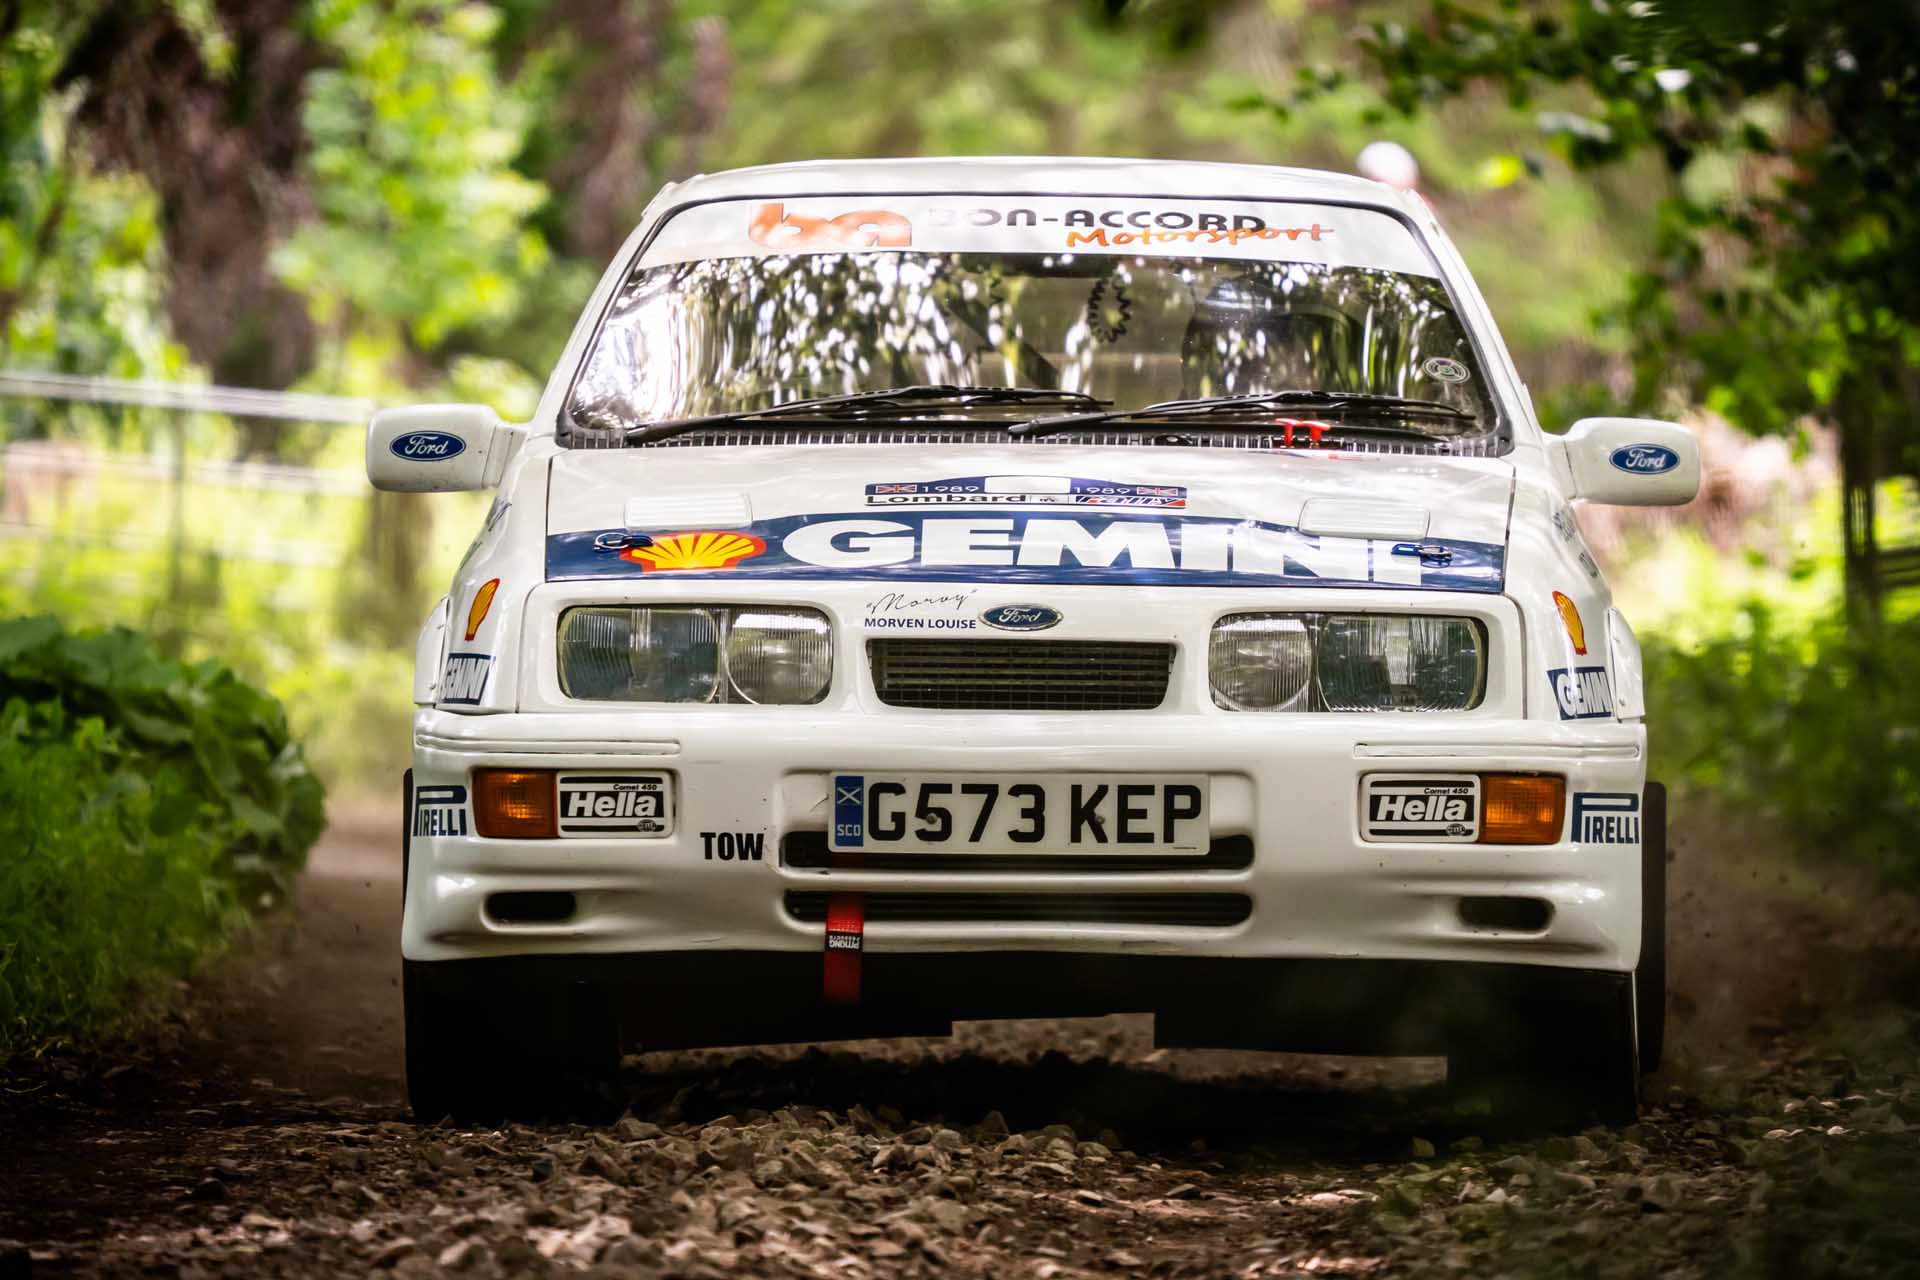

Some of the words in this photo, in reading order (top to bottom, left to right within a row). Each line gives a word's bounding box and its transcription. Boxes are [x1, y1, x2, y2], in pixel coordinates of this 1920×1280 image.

[1067, 223, 1334, 247] Motorsport
[404, 434, 448, 455] Ford
[1625, 447, 1667, 468] Ford
[866, 494, 1026, 505] Lombard
[920, 484, 979, 494] 1989
[1073, 486, 1131, 496] 1989
[783, 519, 1422, 586] GEMINI
[864, 617, 924, 629] MORVEN
[928, 617, 977, 630] LOUISE
[998, 606, 1042, 623] Ford
[413, 785, 468, 837] PIRELLI
[568, 792, 657, 817] Hella
[868, 781, 1046, 842] G573
[1071, 784, 1201, 844] KEP
[1376, 795, 1467, 821] Hella
[1571, 792, 1640, 844] PIRELLI
[837, 823, 862, 837] SCO
[700, 831, 765, 861] TOW
